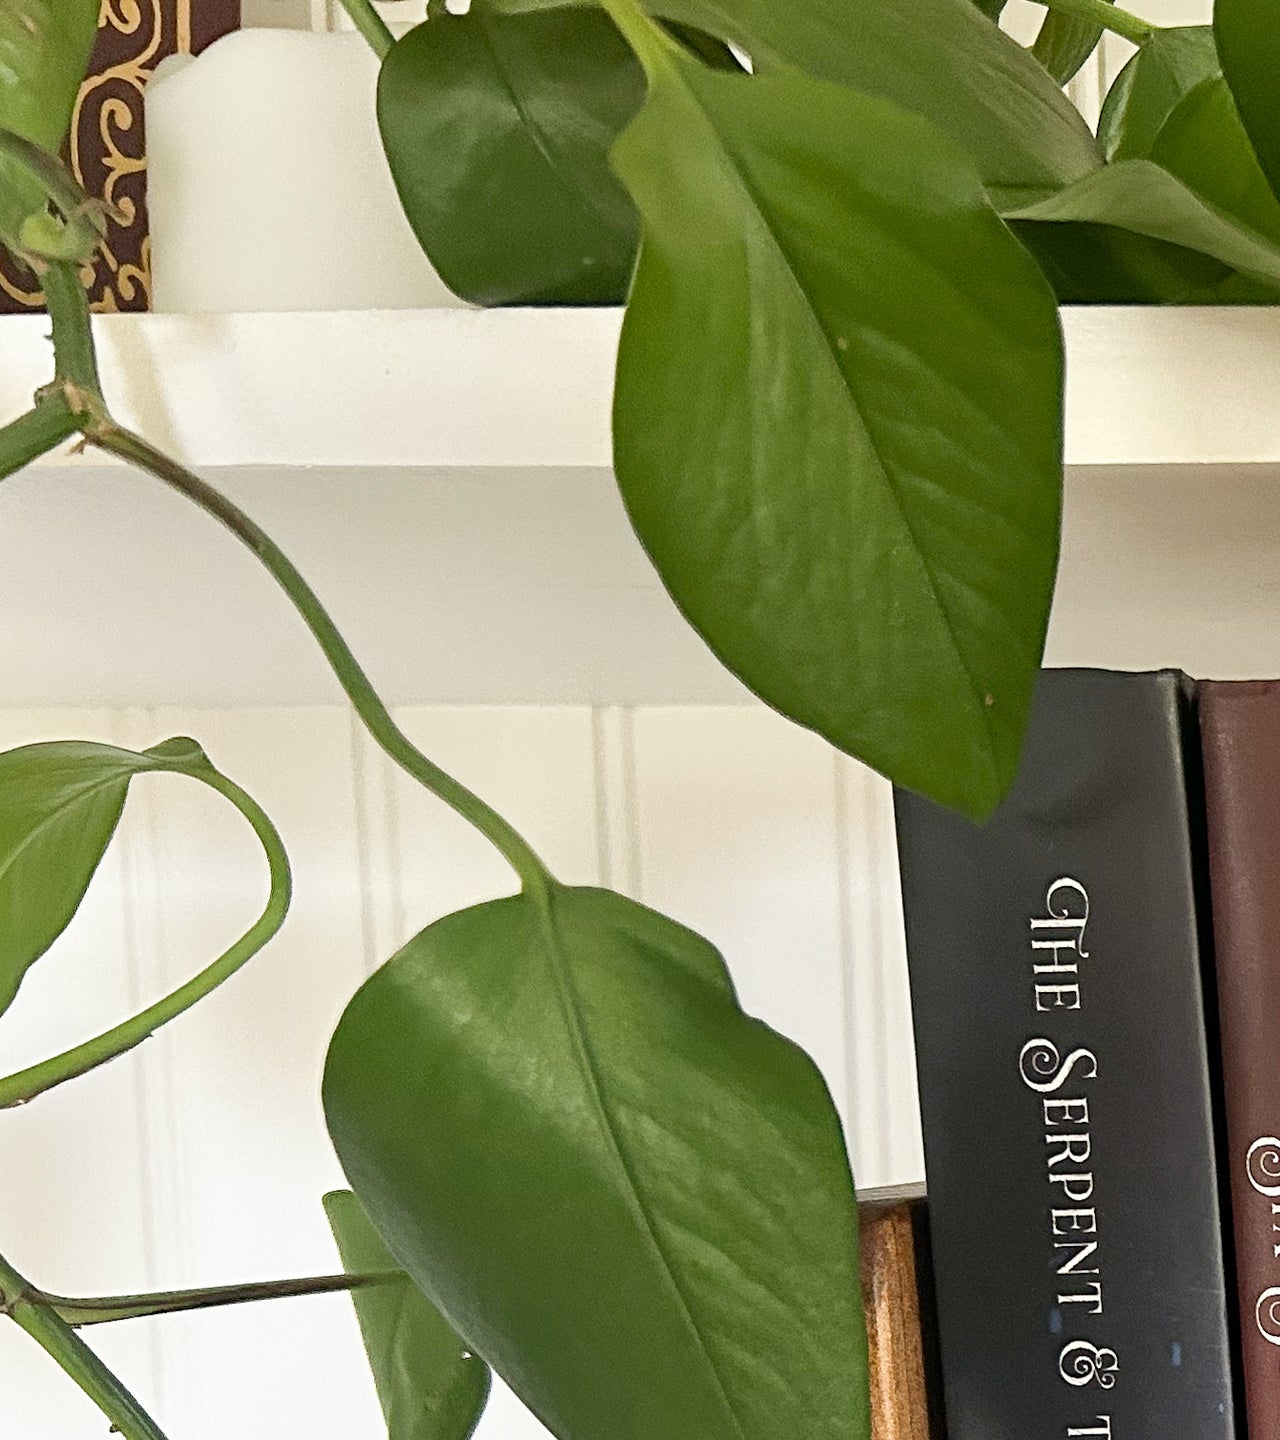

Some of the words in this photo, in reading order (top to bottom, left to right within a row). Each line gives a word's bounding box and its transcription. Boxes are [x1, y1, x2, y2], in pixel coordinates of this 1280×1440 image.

[1030, 877, 1090, 1013] THE
[1019, 1037, 1105, 1315] SERPENT
[1058, 1340, 1120, 1390] &
